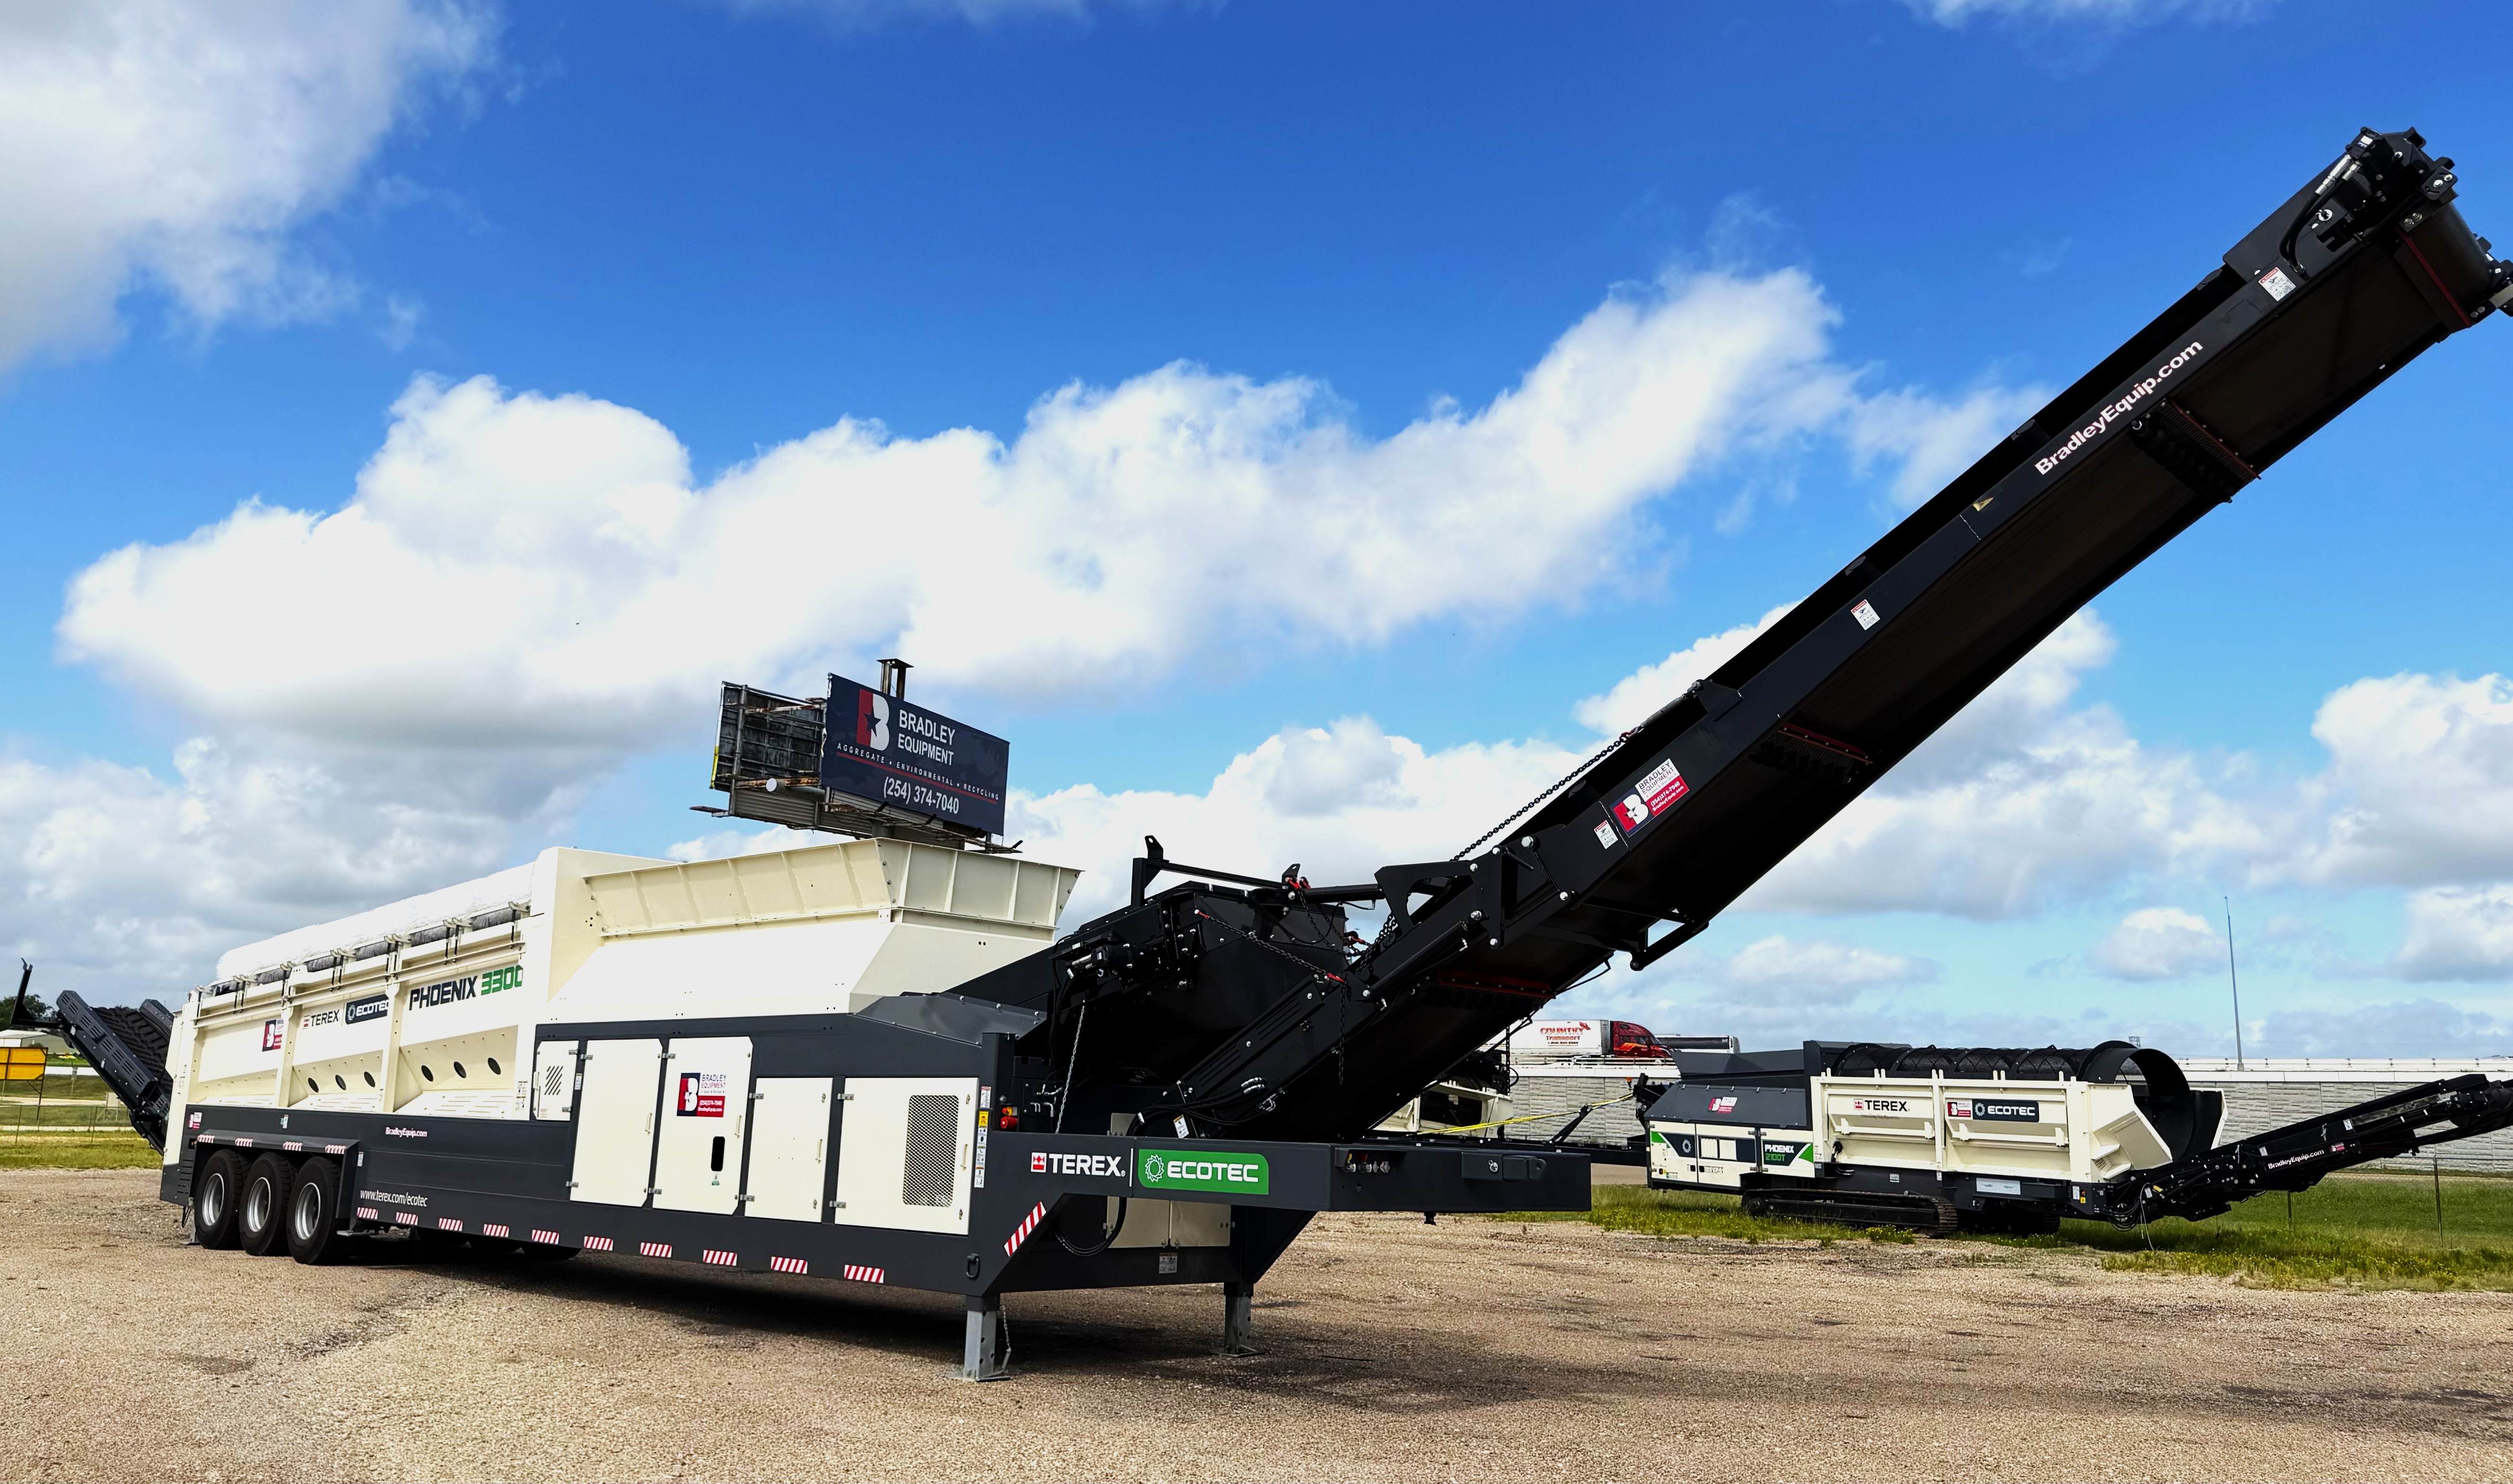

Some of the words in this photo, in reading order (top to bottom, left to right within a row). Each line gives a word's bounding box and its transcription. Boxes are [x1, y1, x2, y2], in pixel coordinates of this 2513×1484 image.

[2034, 340, 2203, 475] BradleyEquip.com
[899, 709, 955, 745] BRADLEY
[898, 733, 954, 765] EQUIPMENT
[837, 743, 885, 764] AGGREGATE
[897, 762, 953, 786] ENVIRONMENTAL
[964, 783, 999, 800] RECYCLING
[1639, 762, 1670, 790] BRADLEY
[1642, 767, 1674, 794] EQUIPMENT
[884, 776, 911, 804] (254)
[914, 785, 959, 814] 374-7040
[409, 976, 478, 1011] PHOENIX
[481, 965, 523, 996] 3300
[311, 1009, 339, 1027] TEREX
[1865, 1100, 1907, 1111] TEREX
[1988, 1105, 2035, 1116] ECOTEC
[385, 1127, 427, 1138] BradleyEquip.com
[1765, 1144, 1794, 1153] PHOENIX
[1765, 1153, 1785, 1162] 2100T
[2268, 1150, 2324, 1169] BradleyEquip.com
[1049, 1154, 1121, 1177] TEREX
[1167, 1161, 1258, 1182] ECOTEC
[360, 1189, 428, 1207] www.terex.com/ecotec
